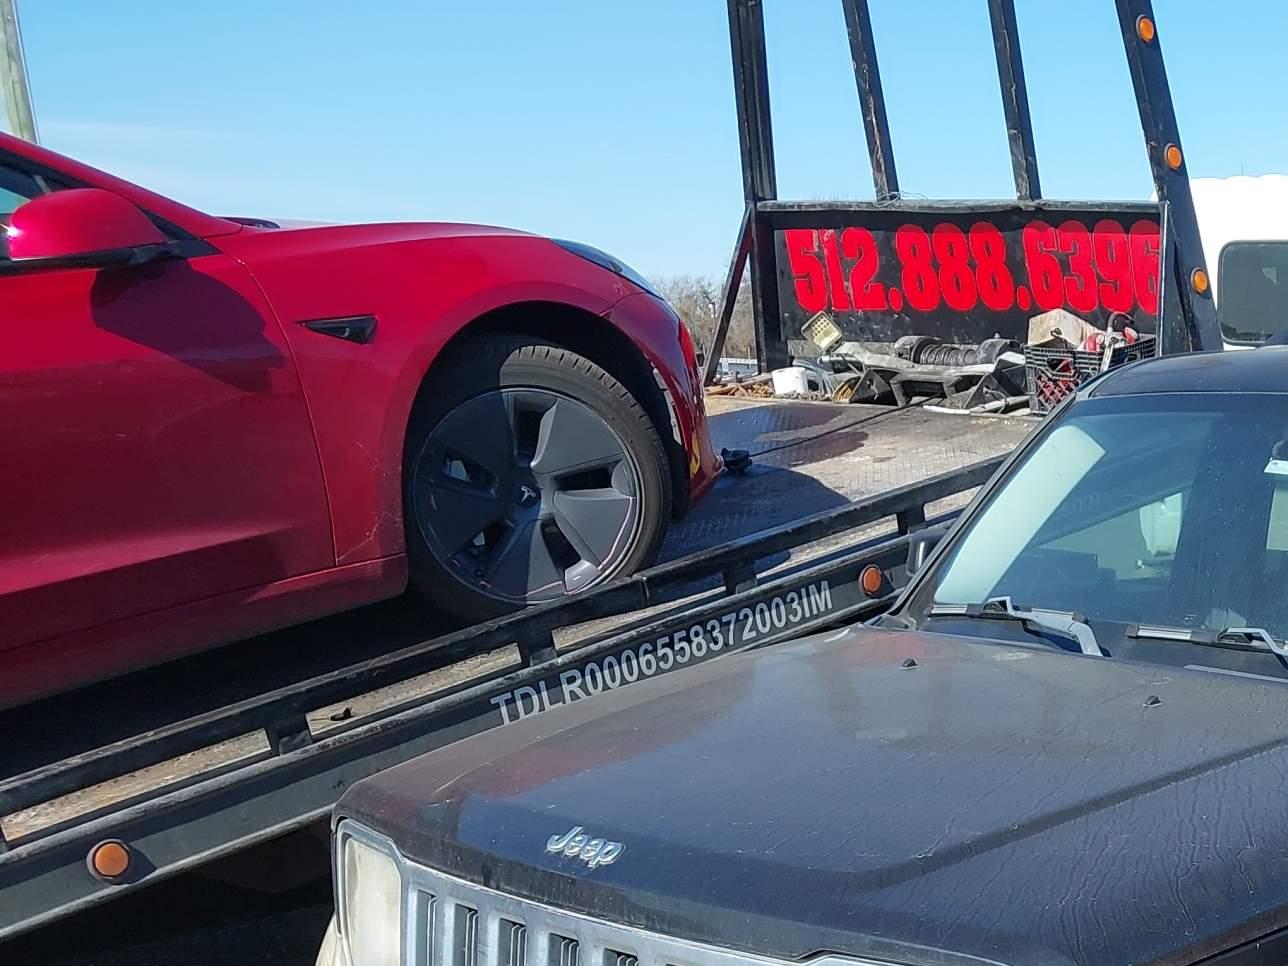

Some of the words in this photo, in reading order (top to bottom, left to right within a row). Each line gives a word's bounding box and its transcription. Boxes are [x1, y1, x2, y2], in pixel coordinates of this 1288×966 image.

[785, 219, 1161, 316] 512.888.6396
[489, 580, 833, 726] TDLR0006558372003IM
[546, 825, 626, 871] Jeep
